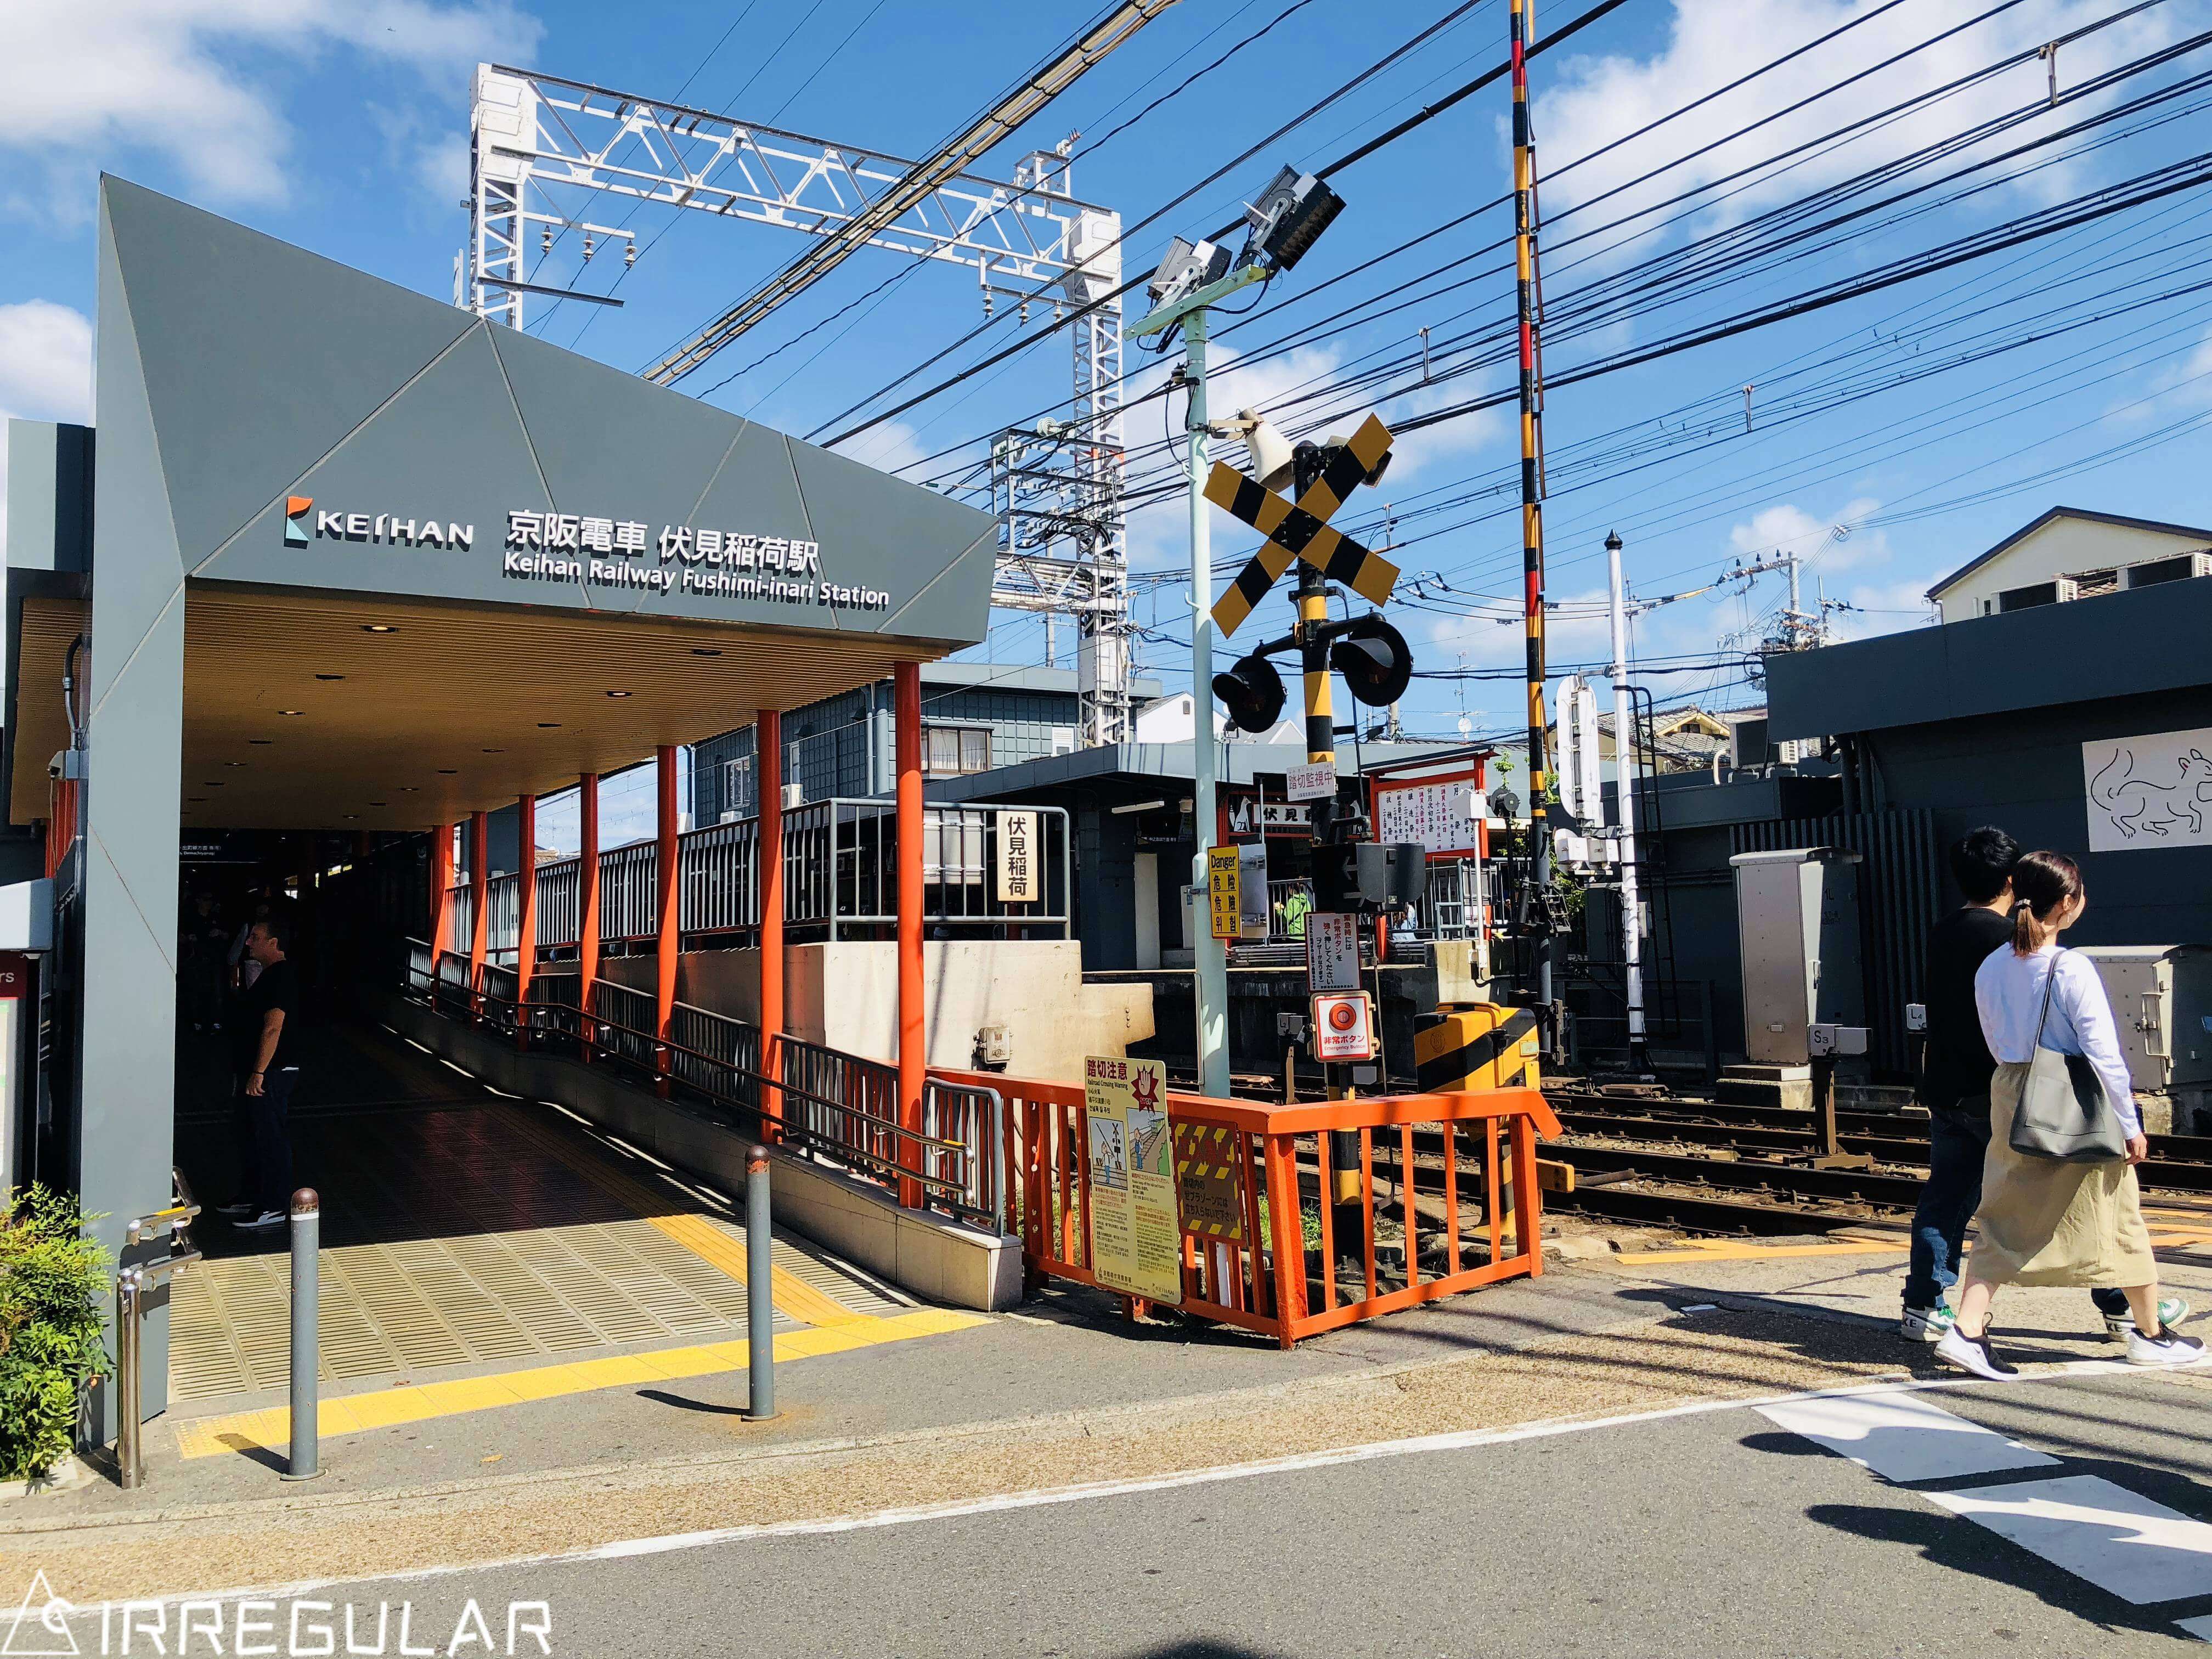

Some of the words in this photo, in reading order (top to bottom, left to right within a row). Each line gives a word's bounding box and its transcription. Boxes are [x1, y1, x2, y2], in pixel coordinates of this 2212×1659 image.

[317, 510, 473, 544] KEIHAN
[507, 509, 648, 554] 京阪電車
[659, 524, 819, 574] 伏見稲荷駅
[504, 551, 582, 577] Keihan
[589, 559, 676, 590] Railway
[682, 568, 815, 599] Fushimi-inari
[820, 582, 889, 606] Station
[1289, 770, 1332, 790] 踏切監視中
[1008, 816, 1028, 896] 伏見稲荷
[1211, 854, 1236, 870] Danger
[1216, 915, 1236, 932] 위험
[1333, 918, 1342, 962] 非常ボタンを
[1323, 1035, 1365, 1045] 非常ボタン
[1814, 1030, 1829, 1044] S3
[1087, 1059, 1127, 1080] 踏切注意
